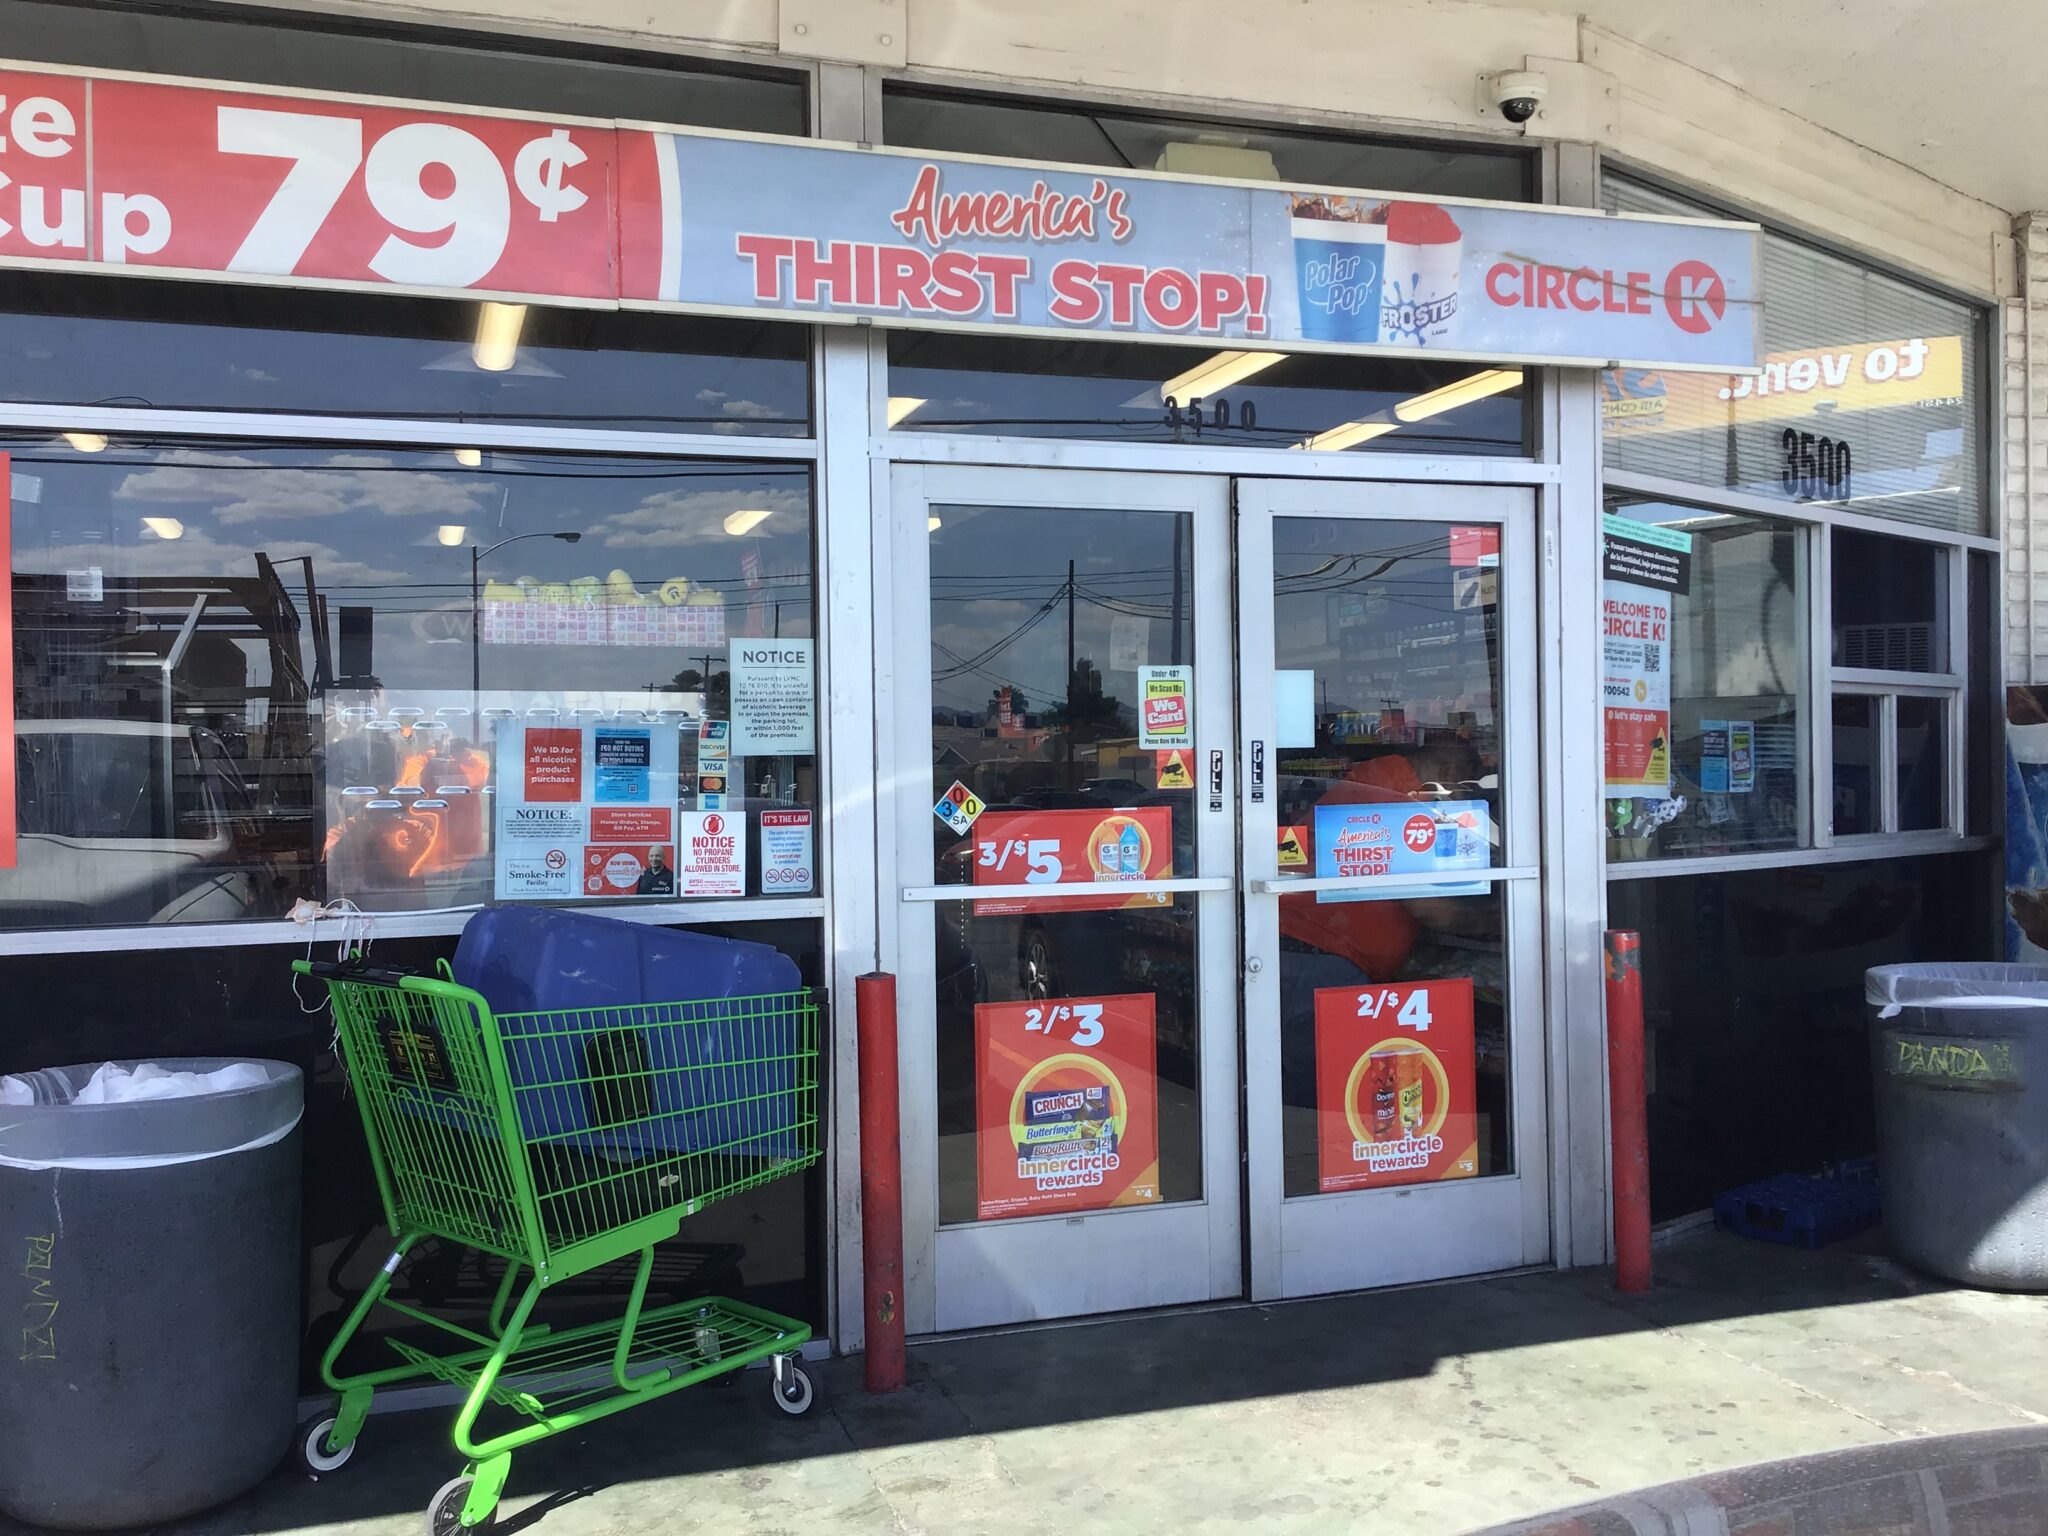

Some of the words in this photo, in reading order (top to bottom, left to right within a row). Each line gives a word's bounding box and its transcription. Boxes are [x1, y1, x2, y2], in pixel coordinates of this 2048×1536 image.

[0, 96, 76, 158] e
[217, 105, 590, 288] 79¢
[892, 164, 1132, 247] America's
[0, 168, 172, 263] up
[1305, 253, 1360, 291] Polar
[737, 233, 1030, 317] THIRST
[1051, 259, 1270, 333] STOP!
[1327, 283, 1368, 315] Pop
[1485, 263, 1651, 314] CIRCLE
[1675, 270, 1725, 332] K
[1381, 292, 1457, 331] FROSTER
[1164, 396, 1257, 434] 3500
[1783, 428, 1850, 500] 3500
[1653, 606, 1667, 620] TO
[1653, 623, 1665, 641] K!
[743, 651, 805, 663] NOTICE
[1152, 700, 1177, 711] We
[1147, 710, 1184, 724] Card
[560, 746, 574, 754] for
[536, 766, 571, 774] product
[703, 762, 724, 771] VISA
[1212, 751, 1221, 793] PULL
[1253, 742, 1262, 784] PULL
[953, 788, 963, 803] 0
[516, 809, 572, 820] NOTICE:
[942, 801, 952, 817] 3
[966, 799, 976, 815] 0
[764, 815, 778, 823] IT'S
[779, 815, 792, 823] THE
[794, 815, 809, 823] LAW
[952, 815, 967, 825] SA
[1372, 814, 1381, 824] K
[692, 836, 735, 848] NOTICE
[1338, 827, 1390, 846] America's
[1406, 829, 1433, 845] 79¢
[978, 839, 1062, 884] 3/$5
[1333, 847, 1394, 863] THIRST
[509, 870, 566, 879] Smoke-Free
[1339, 864, 1390, 877] STOP!
[1357, 989, 1432, 1031] 2/$4
[1024, 1004, 1105, 1047] 2/$3
[1898, 1041, 1991, 1078] PANDA
[1034, 1094, 1082, 1114] CRUNCH
[1026, 1122, 1078, 1140] Butterfinger
[1355, 1138, 1441, 1160] innercircle
[1019, 1154, 1118, 1175] innercircle
[1372, 1154, 1427, 1171] rewards
[1038, 1170, 1101, 1188] rewards
